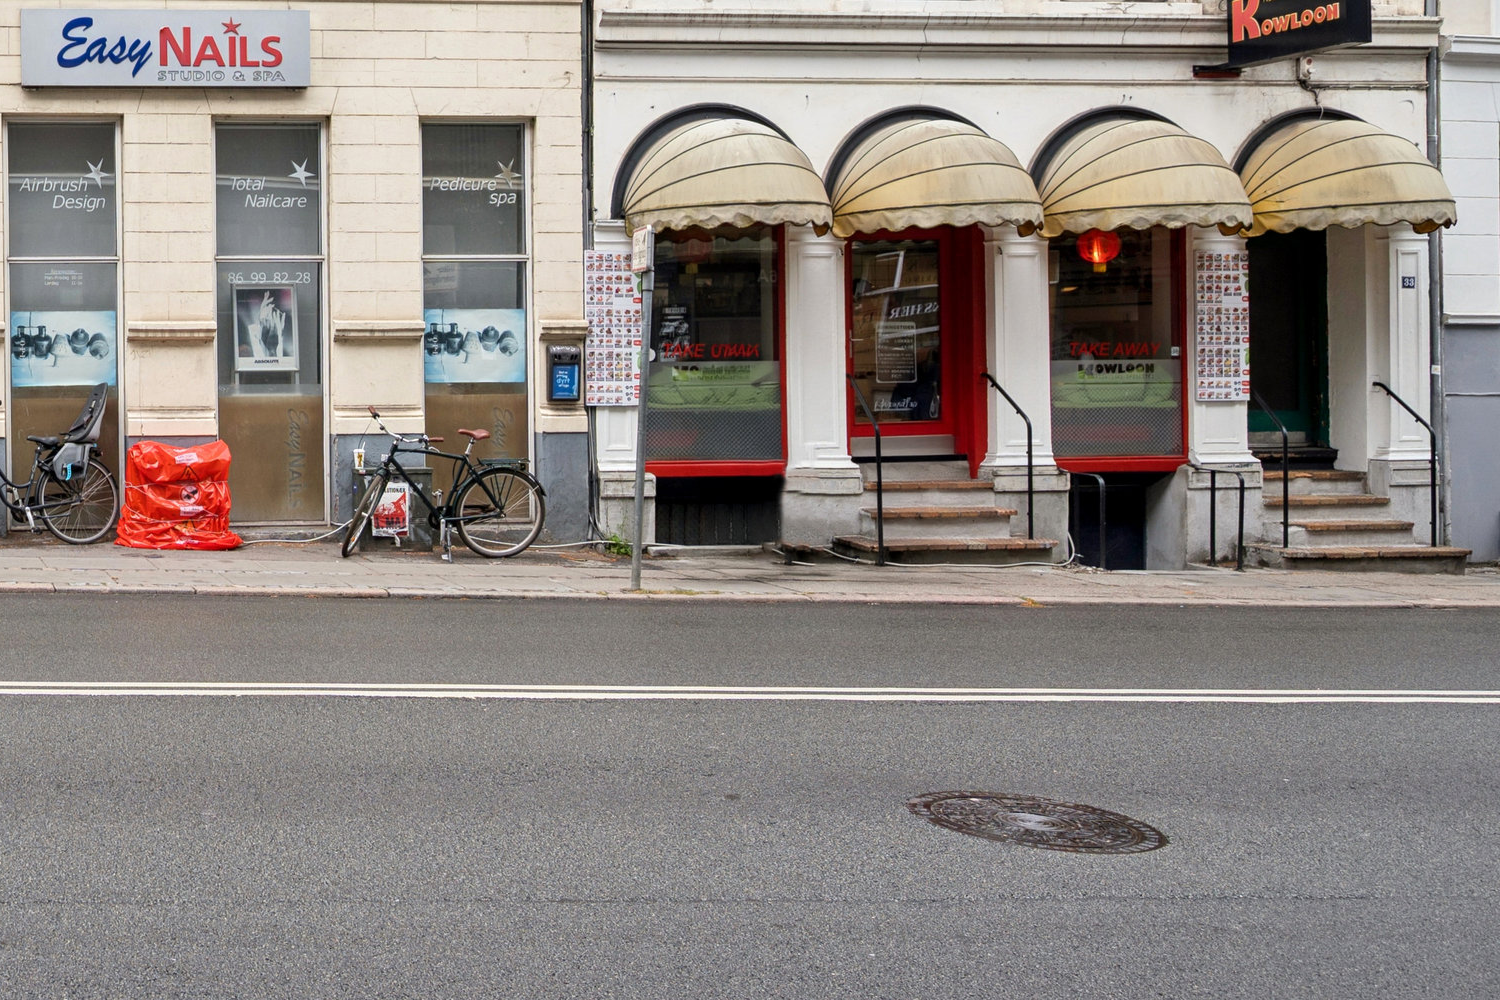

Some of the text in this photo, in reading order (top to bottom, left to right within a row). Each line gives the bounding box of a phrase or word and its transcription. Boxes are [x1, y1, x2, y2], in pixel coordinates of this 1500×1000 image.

[57, 17, 283, 78] Easy NAILS
[157, 70, 286, 82] STUDIO & SPA
[19, 177, 88, 192] Airbrush
[230, 176, 266, 191] Total
[430, 176, 497, 191] Pedicure
[52, 194, 106, 212] Design
[244, 193, 307, 208] Nailcare
[488, 192, 517, 207] spa
[227, 272, 311, 284] 86 99 82 28
[1403, 277, 1415, 287] 33
[663, 343, 705, 358] TAKE
[1069, 342, 1110, 356] TAKE
[1113, 342, 1161, 356] AWAY
